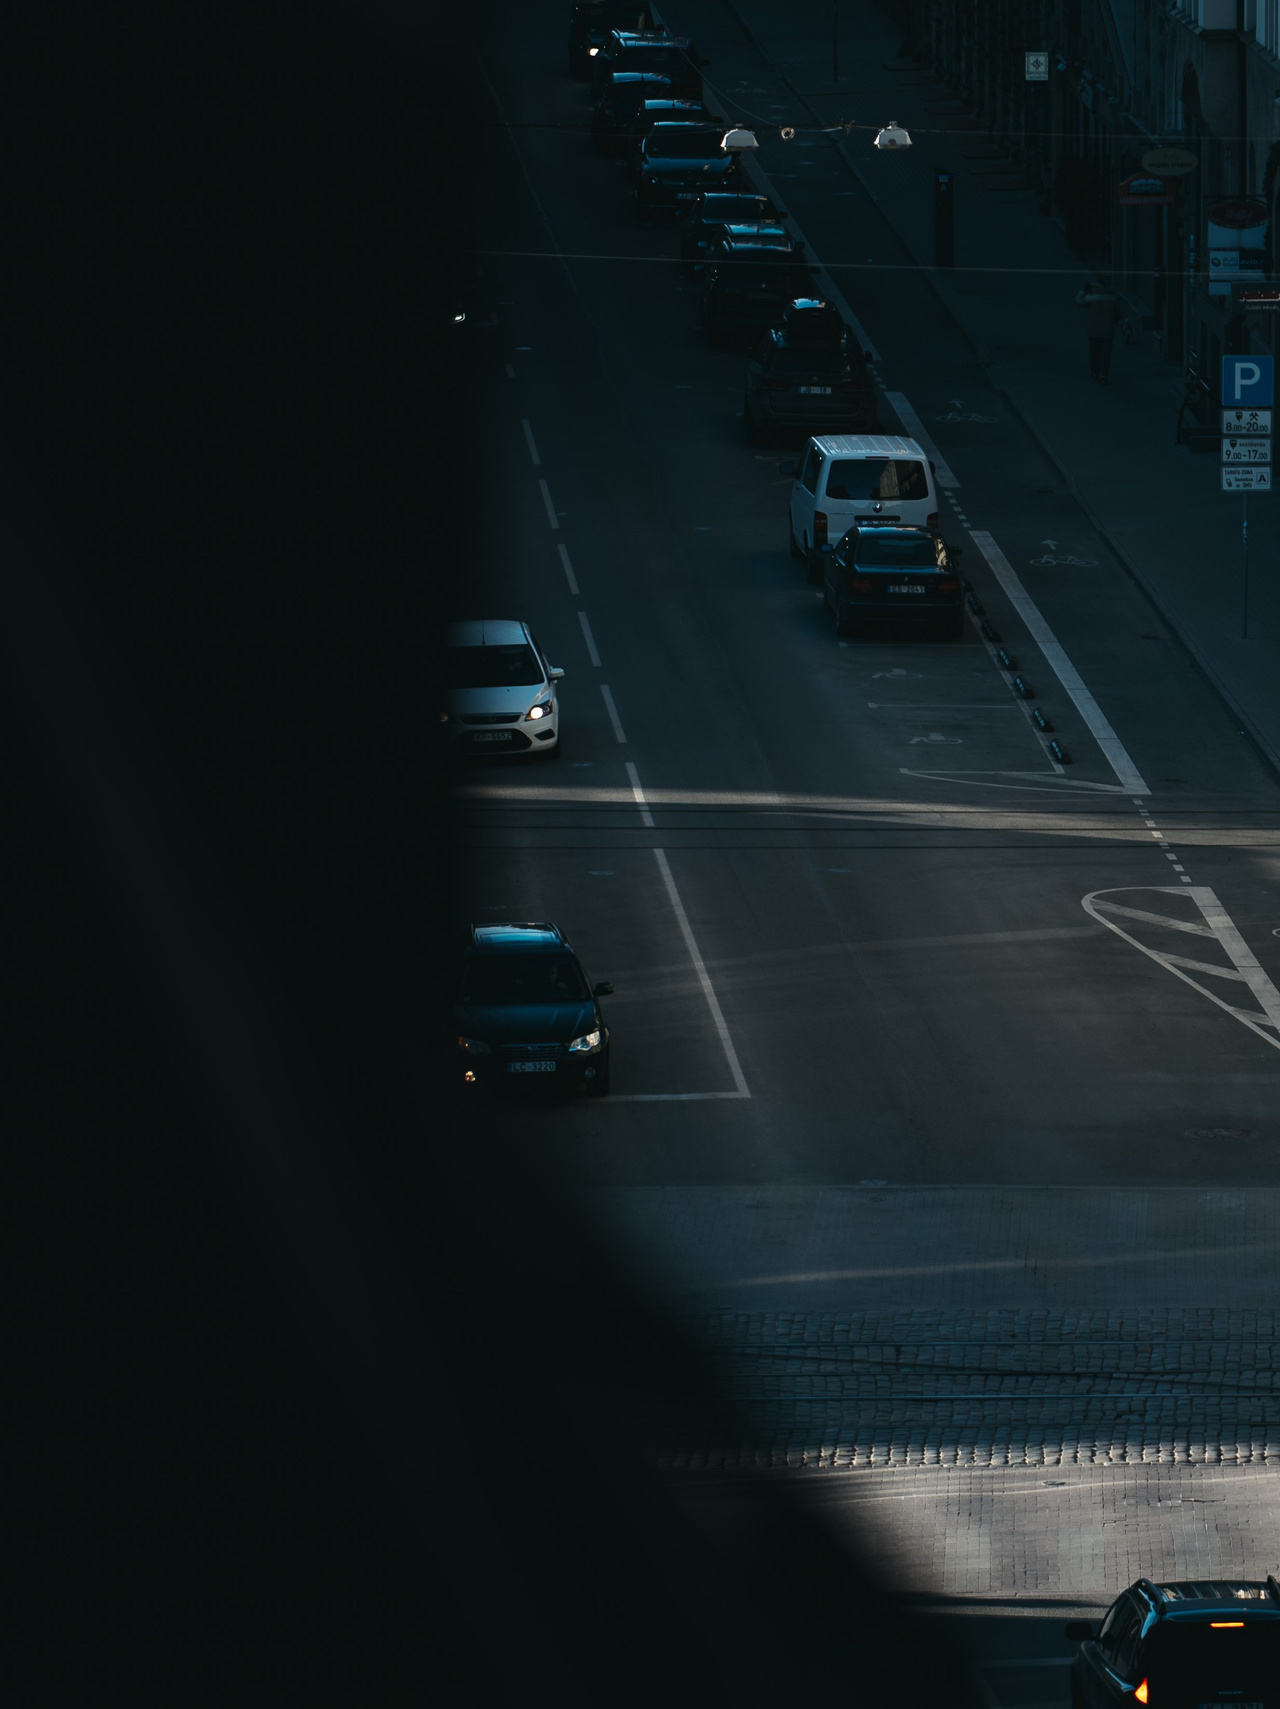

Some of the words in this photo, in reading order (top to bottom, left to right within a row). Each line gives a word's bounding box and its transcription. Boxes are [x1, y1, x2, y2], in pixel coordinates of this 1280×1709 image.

[1234, 362, 1261, 400] P
[1225, 421, 1269, 432] 8.00-20.00
[1225, 449, 1268, 460] 9.00-17.00
[1258, 474, 1267, 483] A
[513, 1060, 555, 1073] LC-3220
